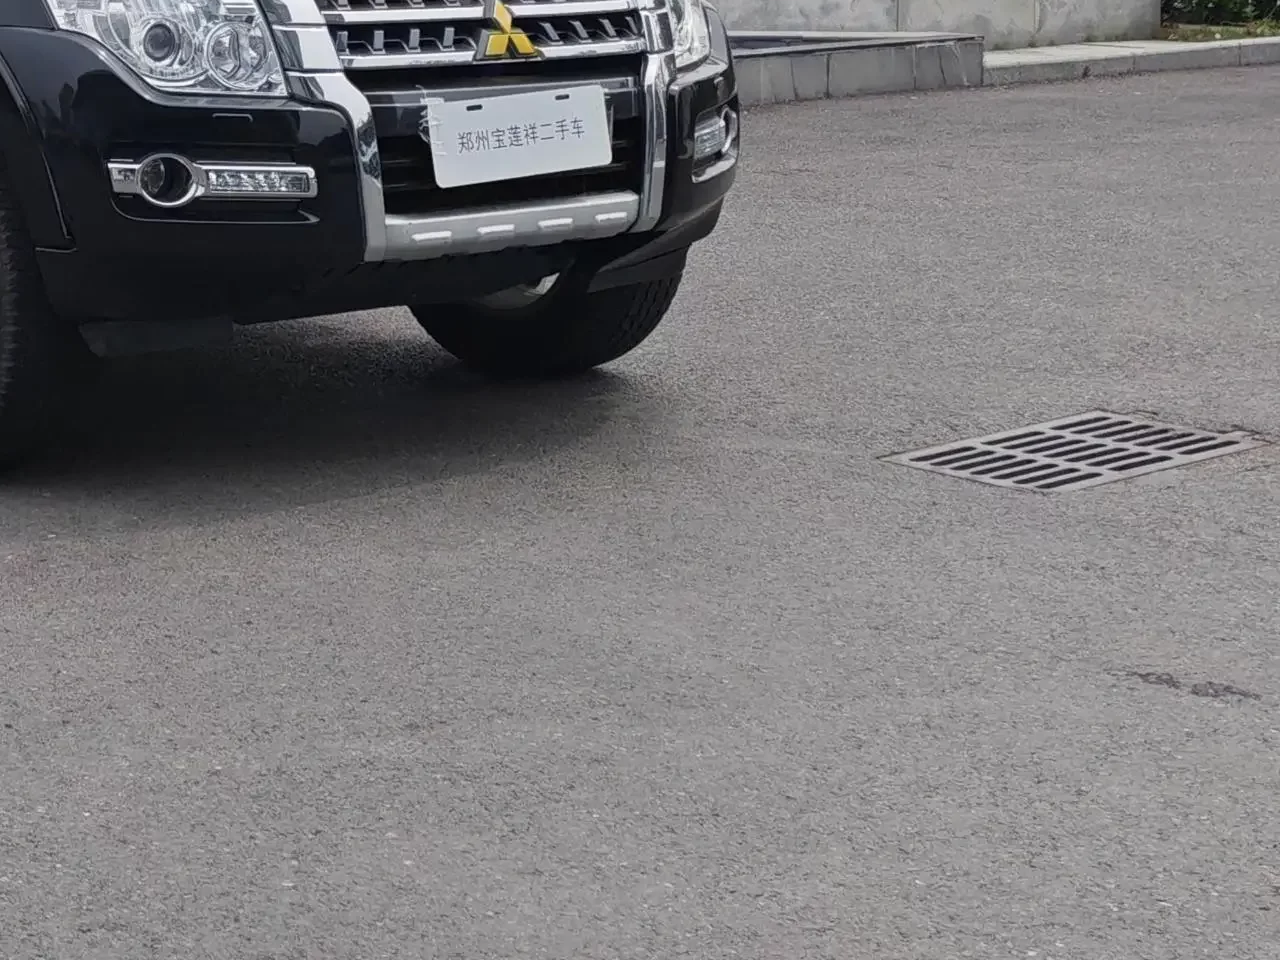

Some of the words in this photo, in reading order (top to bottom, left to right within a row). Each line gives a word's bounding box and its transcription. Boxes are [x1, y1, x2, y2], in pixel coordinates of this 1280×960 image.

[457, 116, 585, 153] 郑州宝莲祥二手车
